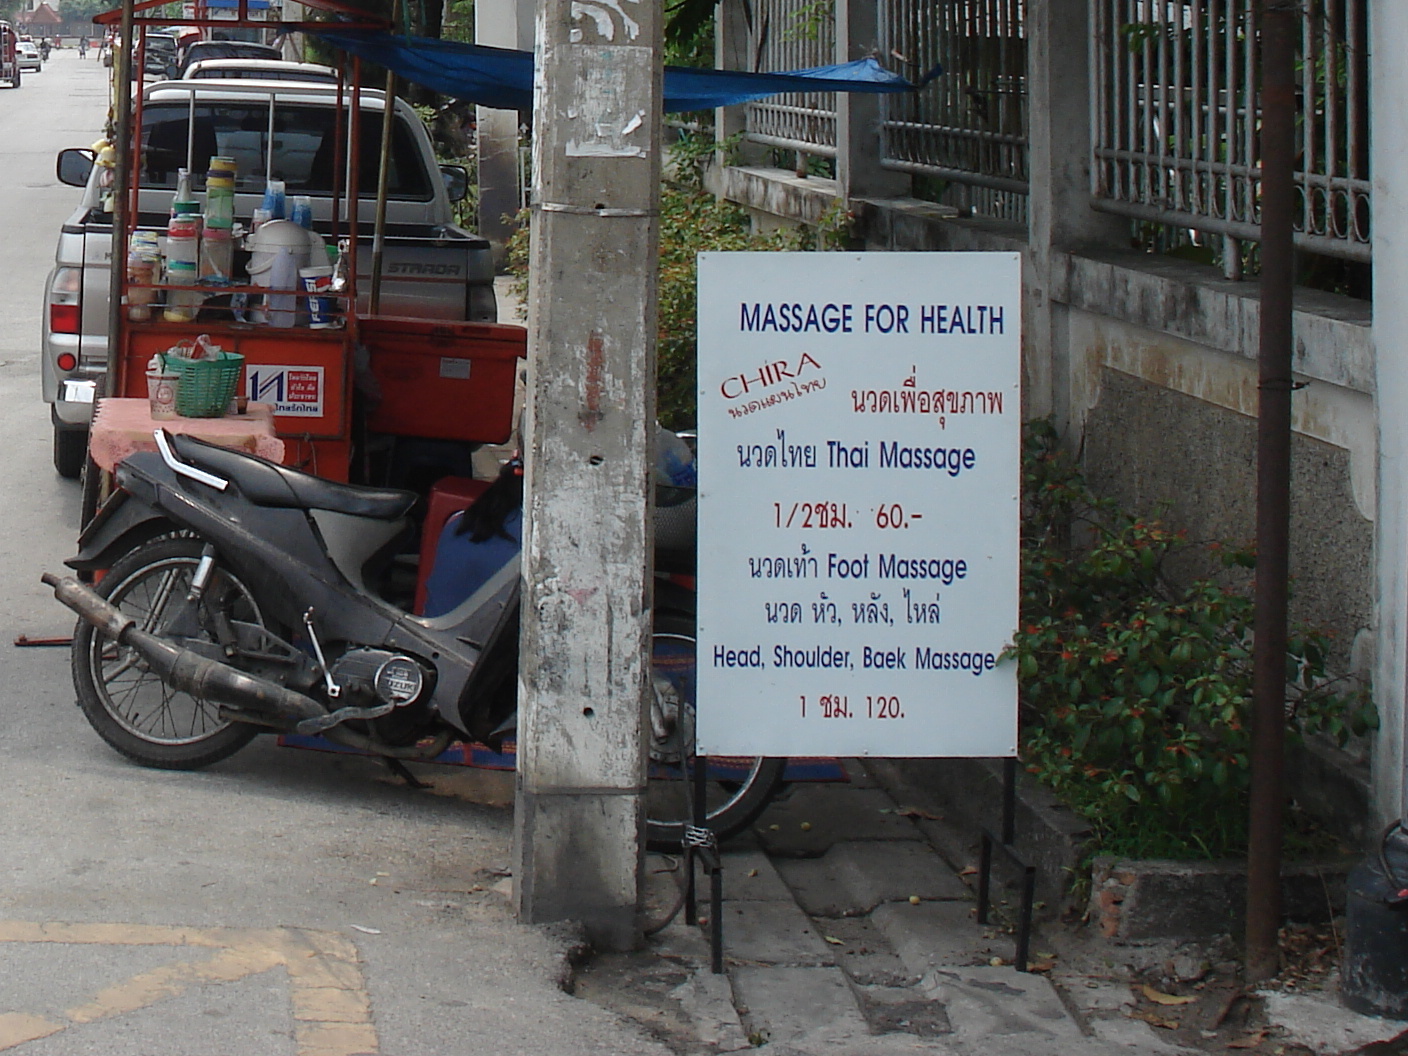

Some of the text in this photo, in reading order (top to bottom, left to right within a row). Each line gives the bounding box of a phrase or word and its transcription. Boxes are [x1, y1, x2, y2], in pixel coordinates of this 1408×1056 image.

[741, 303, 1004, 335] MASSAGE FOR HEALTH
[851, 365, 1004, 430] นวดเพื่อสุขภาพ
[736, 428, 976, 477] นวดไทย Thai Massage
[748, 543, 968, 585] นวดเท้า Foot Massage
[764, 601, 802, 624] นวด
[903, 587, 941, 624] ไหล่
[713, 645, 765, 670] Head,
[773, 645, 855, 671] Shoulder,
[915, 647, 996, 676] Massage
[799, 695, 806, 718] 1
